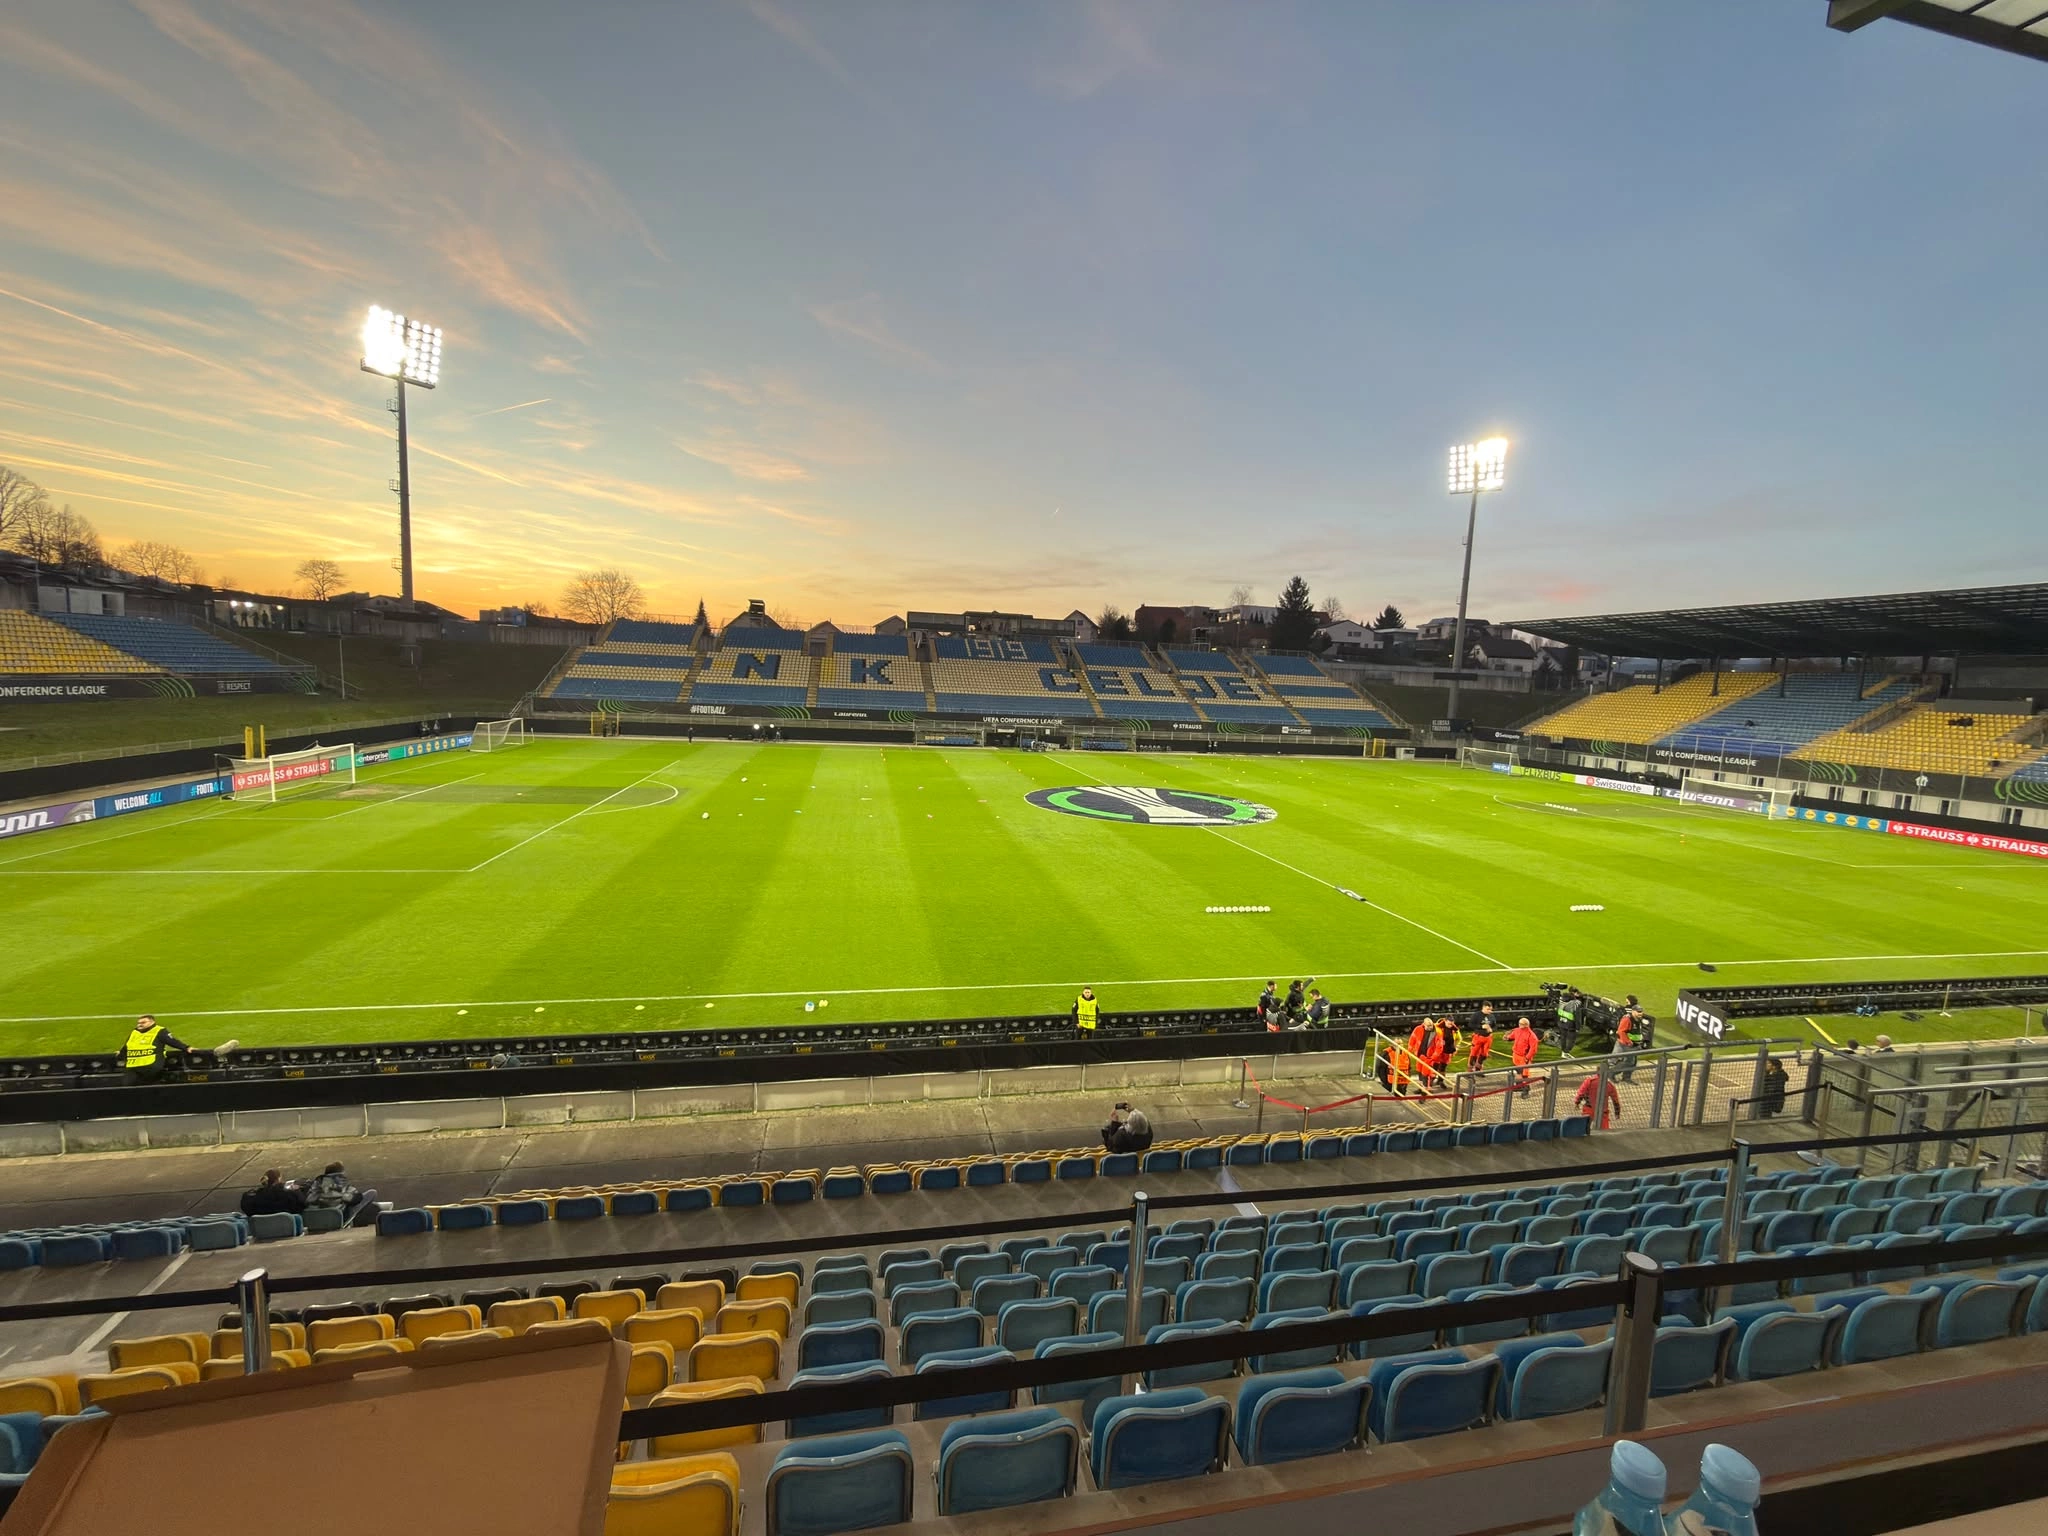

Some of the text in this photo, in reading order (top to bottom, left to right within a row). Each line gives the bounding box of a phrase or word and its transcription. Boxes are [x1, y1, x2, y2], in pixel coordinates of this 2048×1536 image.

[65, 685, 107, 695] LEAGUE
[690, 704, 726, 715] #FOOTBALL
[1000, 717, 1039, 725] CONFERENCE
[1655, 749, 1757, 767] UEFA CONFERENCE LEAGUE
[1594, 778, 1642, 793] Swissquote
[114, 791, 163, 811] WELCOME ALL
[1905, 825, 2048, 856] STRAUSS STRAUSS
[1675, 997, 1724, 1040] NFER
